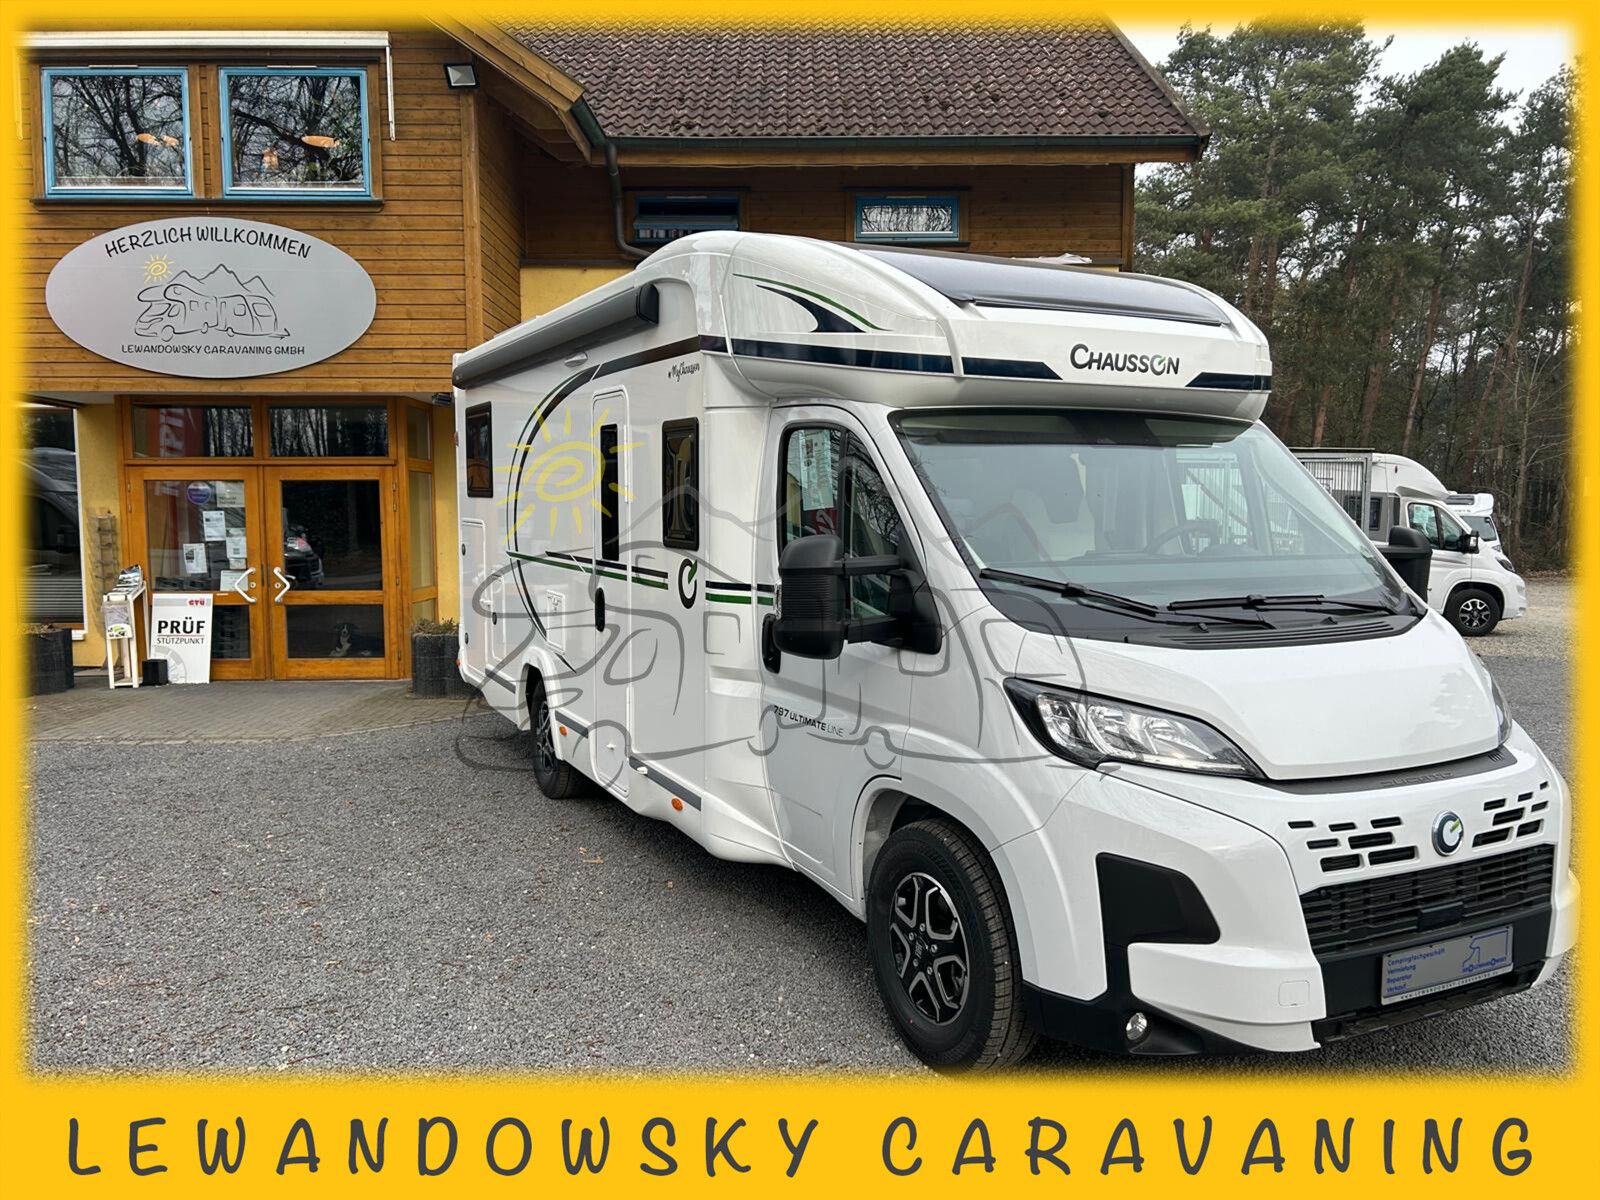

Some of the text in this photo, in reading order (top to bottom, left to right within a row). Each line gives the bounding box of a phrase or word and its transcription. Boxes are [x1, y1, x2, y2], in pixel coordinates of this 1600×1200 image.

[105, 226, 312, 259] HERZLICH WILLKOMMEN
[121, 344, 305, 356] LEWANDOWSKY CARAVANING GMBH
[1070, 343, 1180, 376] CHAUSSON
[157, 616, 206, 634] PRÜF
[157, 635, 205, 645] STÜTZPUNKT
[789, 713, 827, 731] ULTIMATE
[826, 724, 844, 737] LINE
